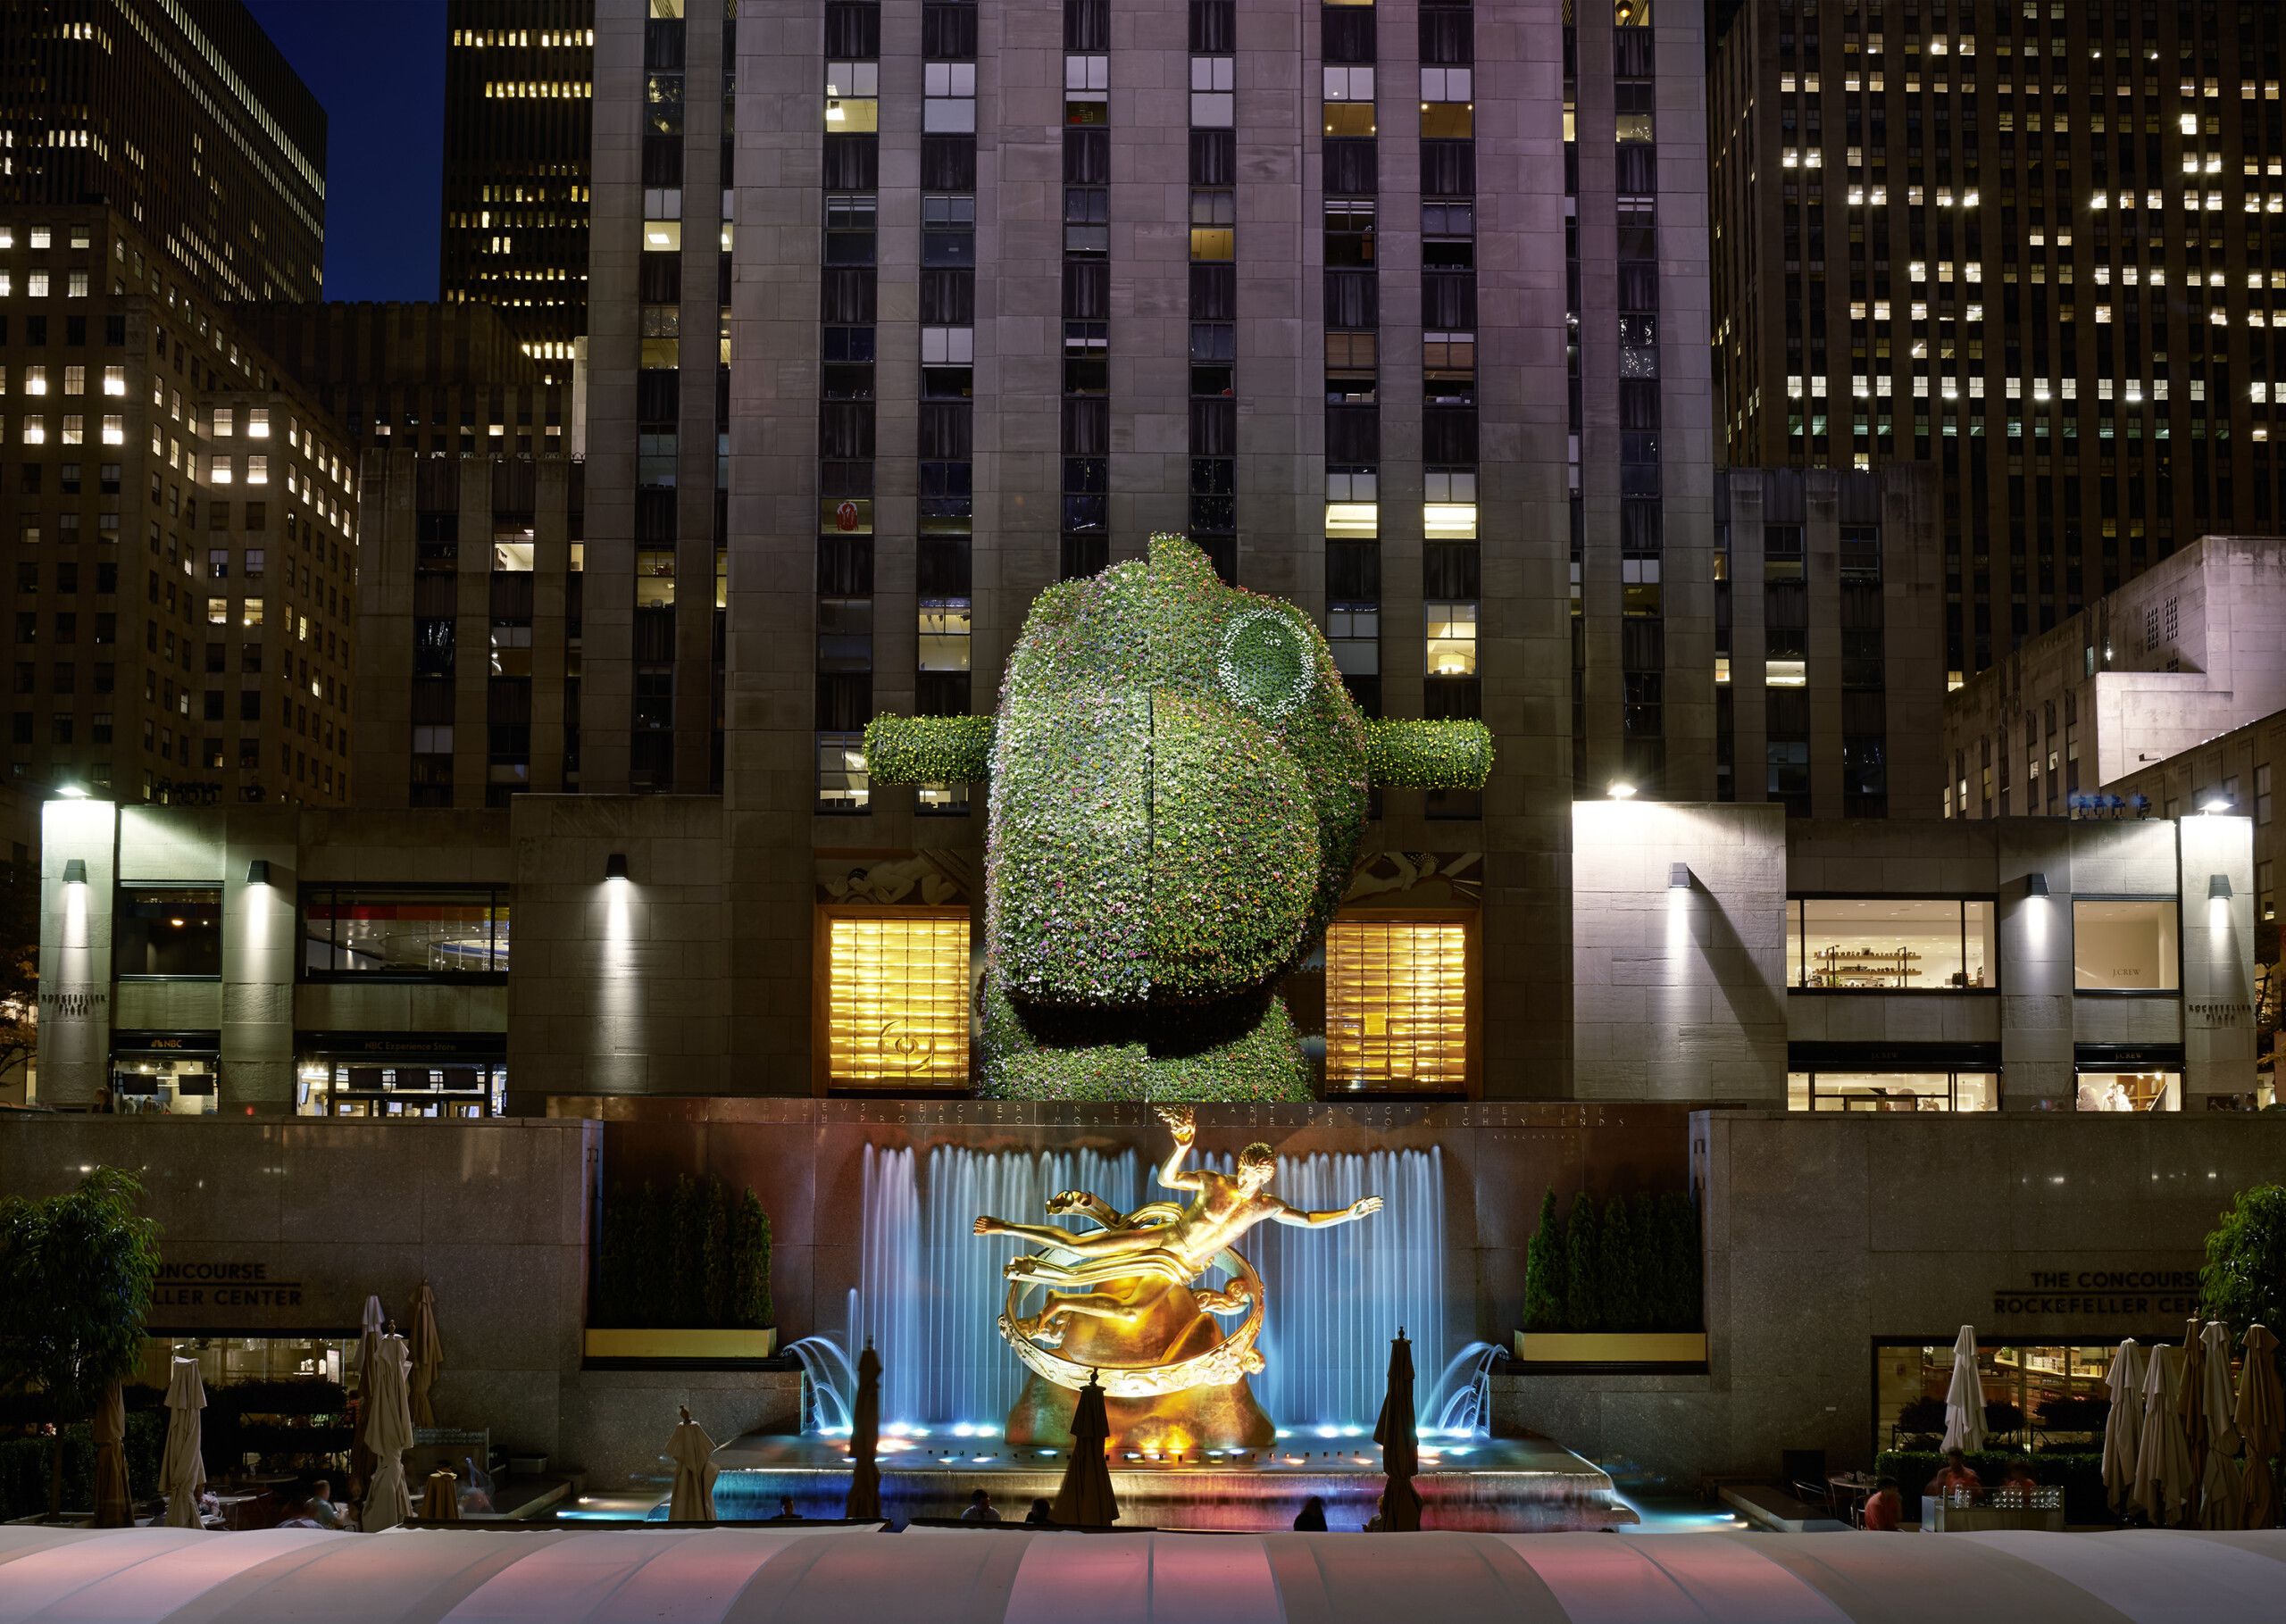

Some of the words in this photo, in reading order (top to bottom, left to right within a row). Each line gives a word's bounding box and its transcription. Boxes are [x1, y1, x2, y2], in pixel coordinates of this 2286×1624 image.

[2113, 969, 2141, 978] J.CREW
[2189, 1004, 2252, 1013] ROCKEFELLER
[2207, 1014, 2236, 1022] PLAZA
[163, 1039, 183, 1048] NBC
[364, 1041, 384, 1050] NBC
[386, 1041, 432, 1052] Experience
[433, 1042, 457, 1051] Store
[2115, 1050, 2143, 1061] J.CREW
[898, 1103, 1022, 1114] TEACHER
[1056, 1104, 1080, 1115] IN
[1229, 1105, 1275, 1115] ART
[1463, 1105, 1509, 1116] THE
[1540, 1106, 1606, 1116] FIRE
[860, 1114, 964, 1124] PROVED
[997, 1115, 1023, 1125] TO
[1054, 1116, 1161, 1126] MORTAL
[1209, 1117, 1217, 1126] A
[1248, 1117, 1335, 1127] MEANS
[1365, 1117, 1393, 1127] TO
[1423, 1117, 1528, 1128] MIGHTY
[1560, 1118, 1625, 1128] ENDS
[2032, 1272, 2070, 1287] THE
[214, 1289, 301, 1306] CENTER
[1995, 1297, 2148, 1314] ROCKEFELLER
